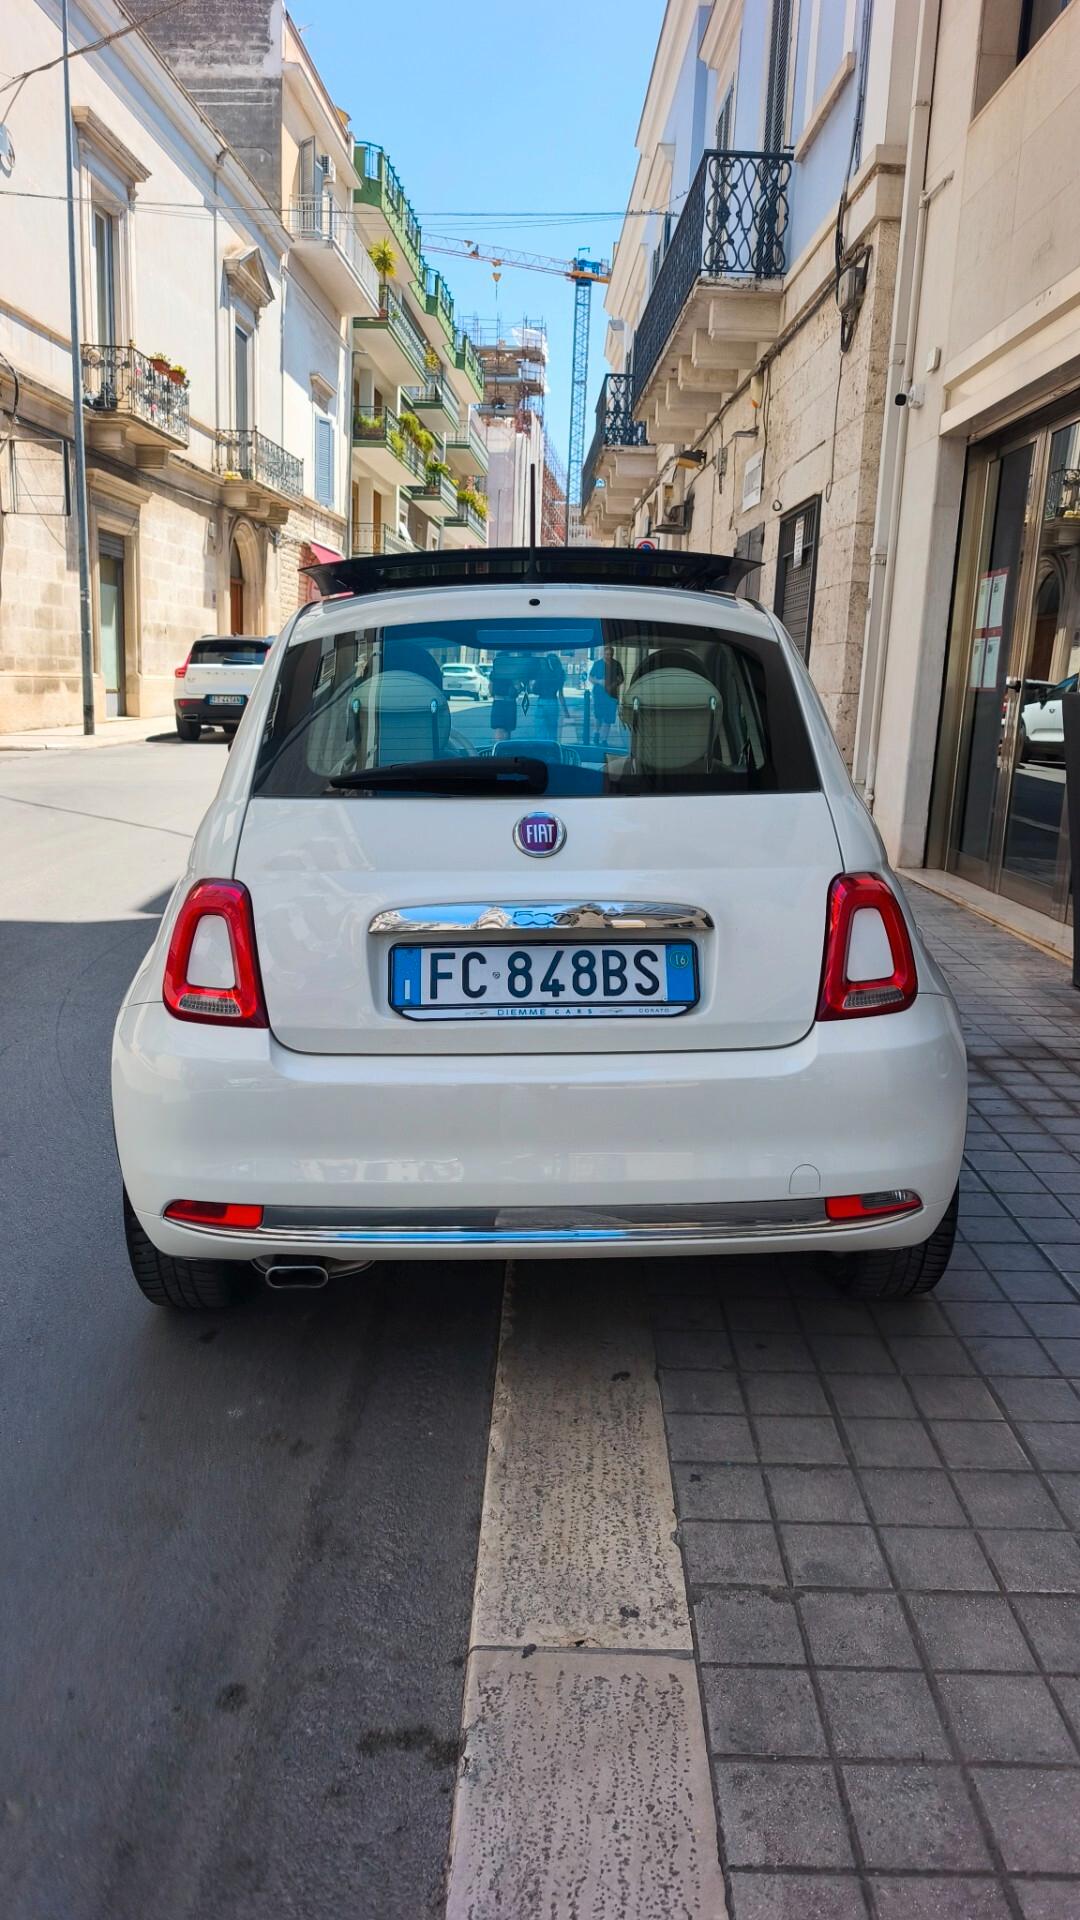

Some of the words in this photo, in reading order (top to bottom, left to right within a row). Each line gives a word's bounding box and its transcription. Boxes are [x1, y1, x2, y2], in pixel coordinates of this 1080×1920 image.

[526, 824, 554, 844] FIAT
[674, 954, 687, 965] 16
[430, 951, 488, 1000] FC
[507, 949, 660, 998] 848BS
[497, 1008, 545, 1016] DIEMME
